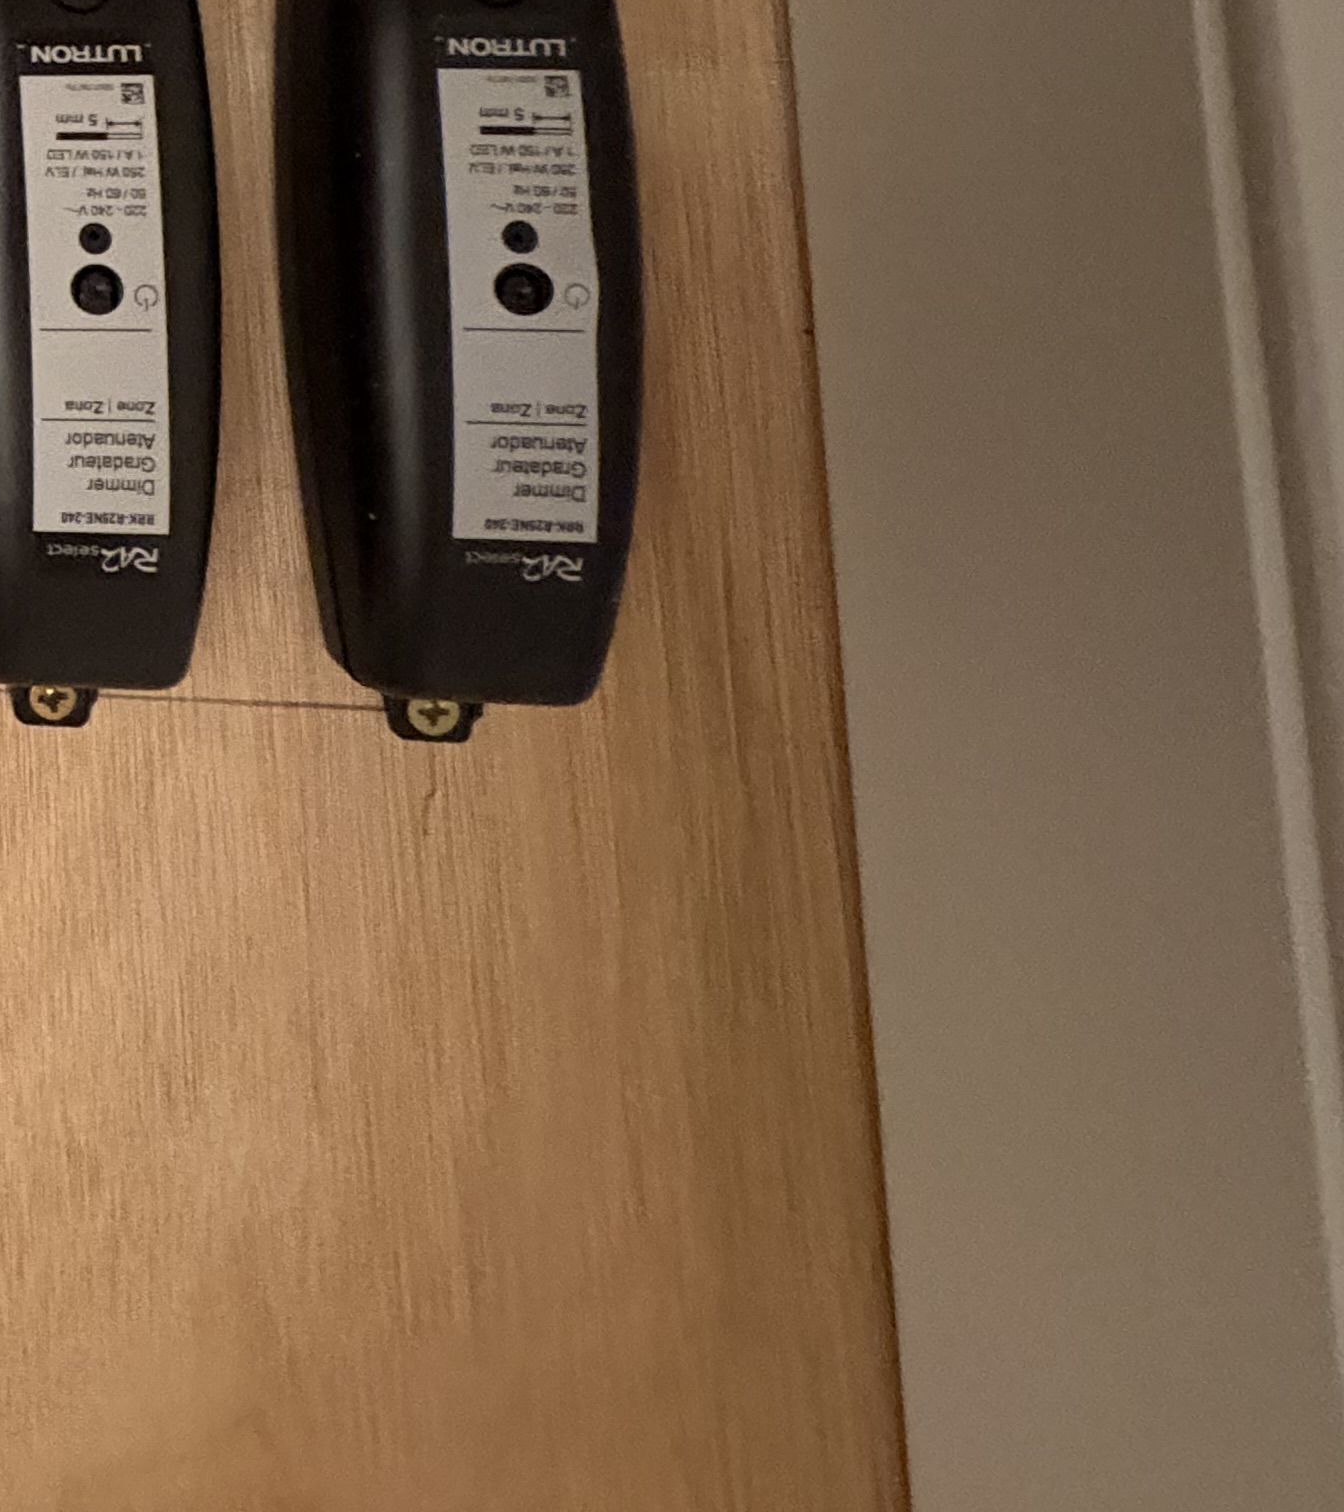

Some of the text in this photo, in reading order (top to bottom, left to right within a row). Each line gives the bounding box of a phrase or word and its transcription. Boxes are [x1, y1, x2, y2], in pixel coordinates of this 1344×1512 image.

[31, 44, 142, 63] LUTRON
[449, 38, 566, 57] LUTRON
[56, 114, 98, 125] 5 mm
[514, 109, 524, 121] 5
[65, 401, 155, 414] Zone Zona
[66, 433, 155, 449] Atenuador
[491, 436, 587, 454] Atenuador
[69, 455, 155, 472] Gradateur
[494, 459, 586, 477] Gradateur
[87, 478, 155, 496] Dimmer
[513, 484, 586, 502] Dimmer
[101, 547, 159, 573] RA2
